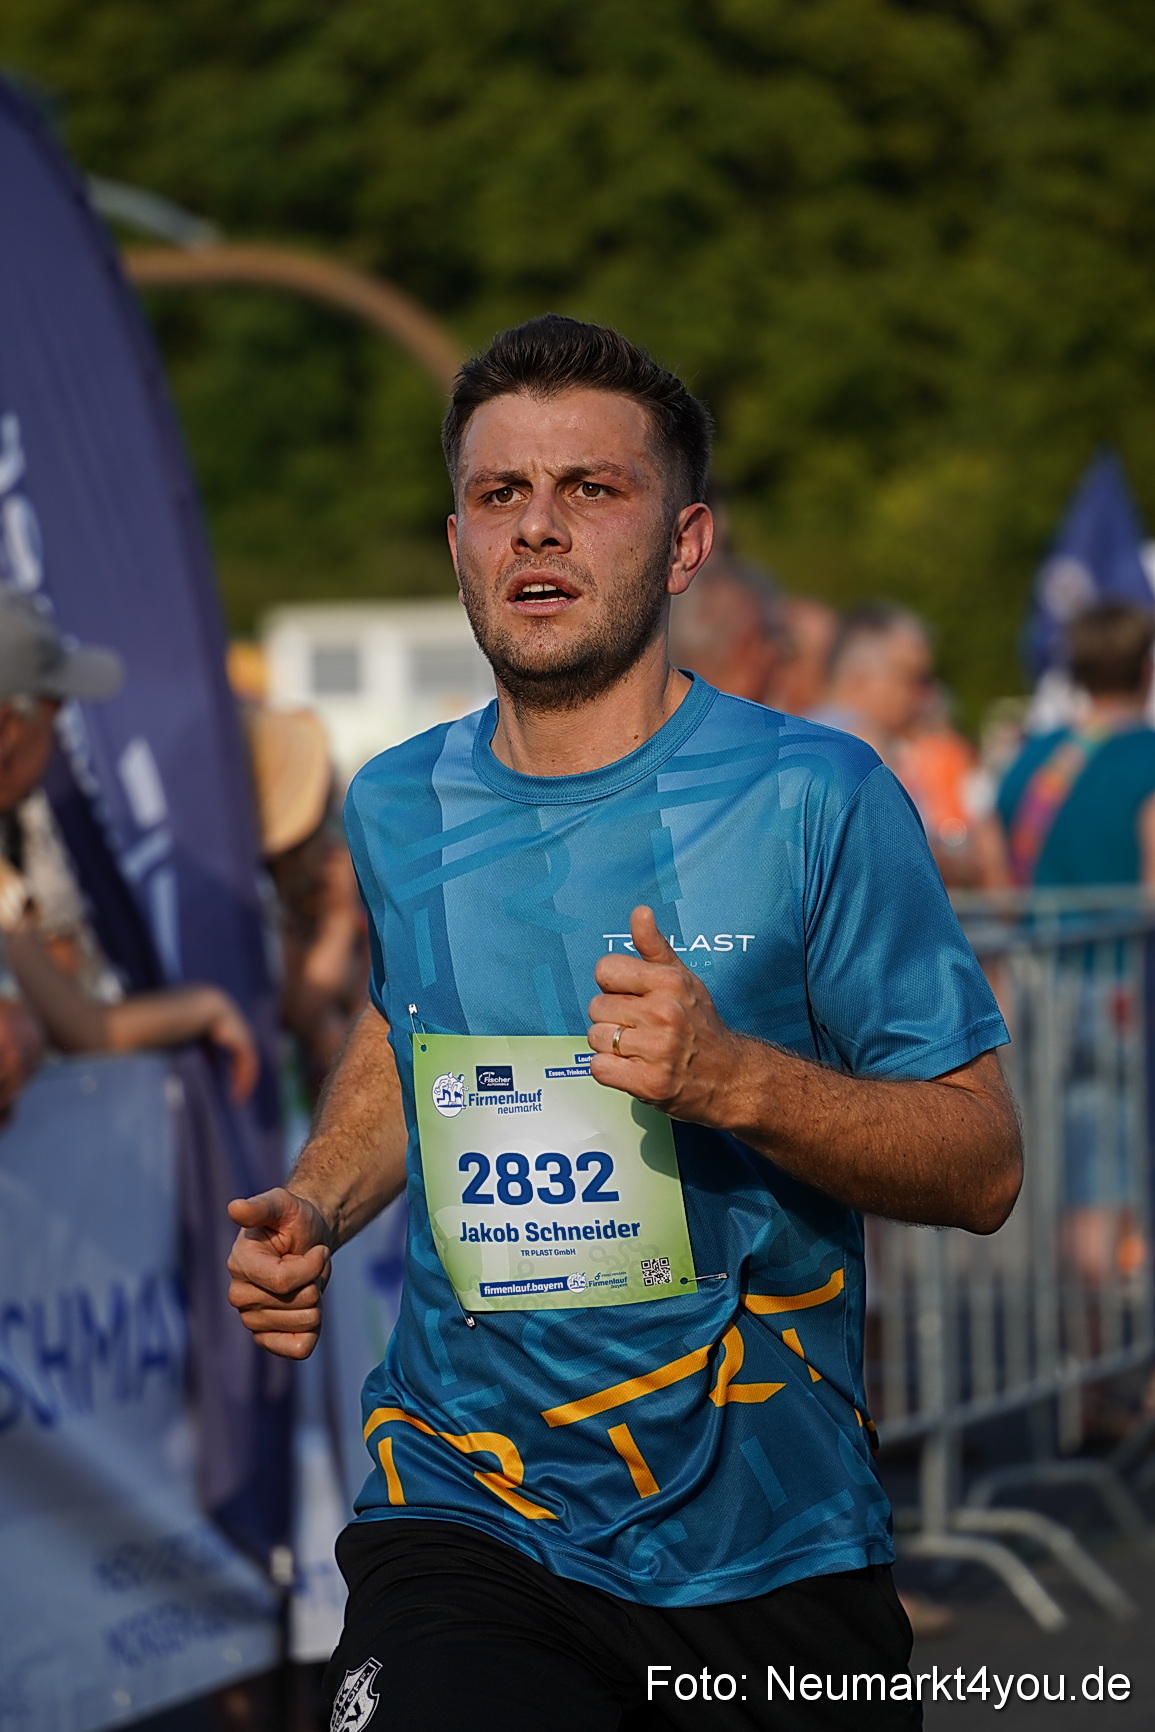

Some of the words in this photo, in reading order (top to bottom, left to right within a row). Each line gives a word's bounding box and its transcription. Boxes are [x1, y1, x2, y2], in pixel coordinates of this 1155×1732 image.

[669, 933, 756, 952] LAST
[566, 1068, 588, 1076] Trinken,
[468, 1088, 543, 1107] Firmenlauf
[497, 1102, 543, 1115] neumarkt
[458, 1151, 620, 1206] 2832
[459, 1221, 520, 1243] Jakob
[524, 1219, 641, 1241] Schneider
[520, 1249, 530, 1257] TR
[531, 1249, 553, 1257] PLAST
[554, 1248, 576, 1256] GmbH
[483, 1279, 564, 1296] firmenlauf.bayern
[588, 1275, 628, 1288] Firmenlauf
